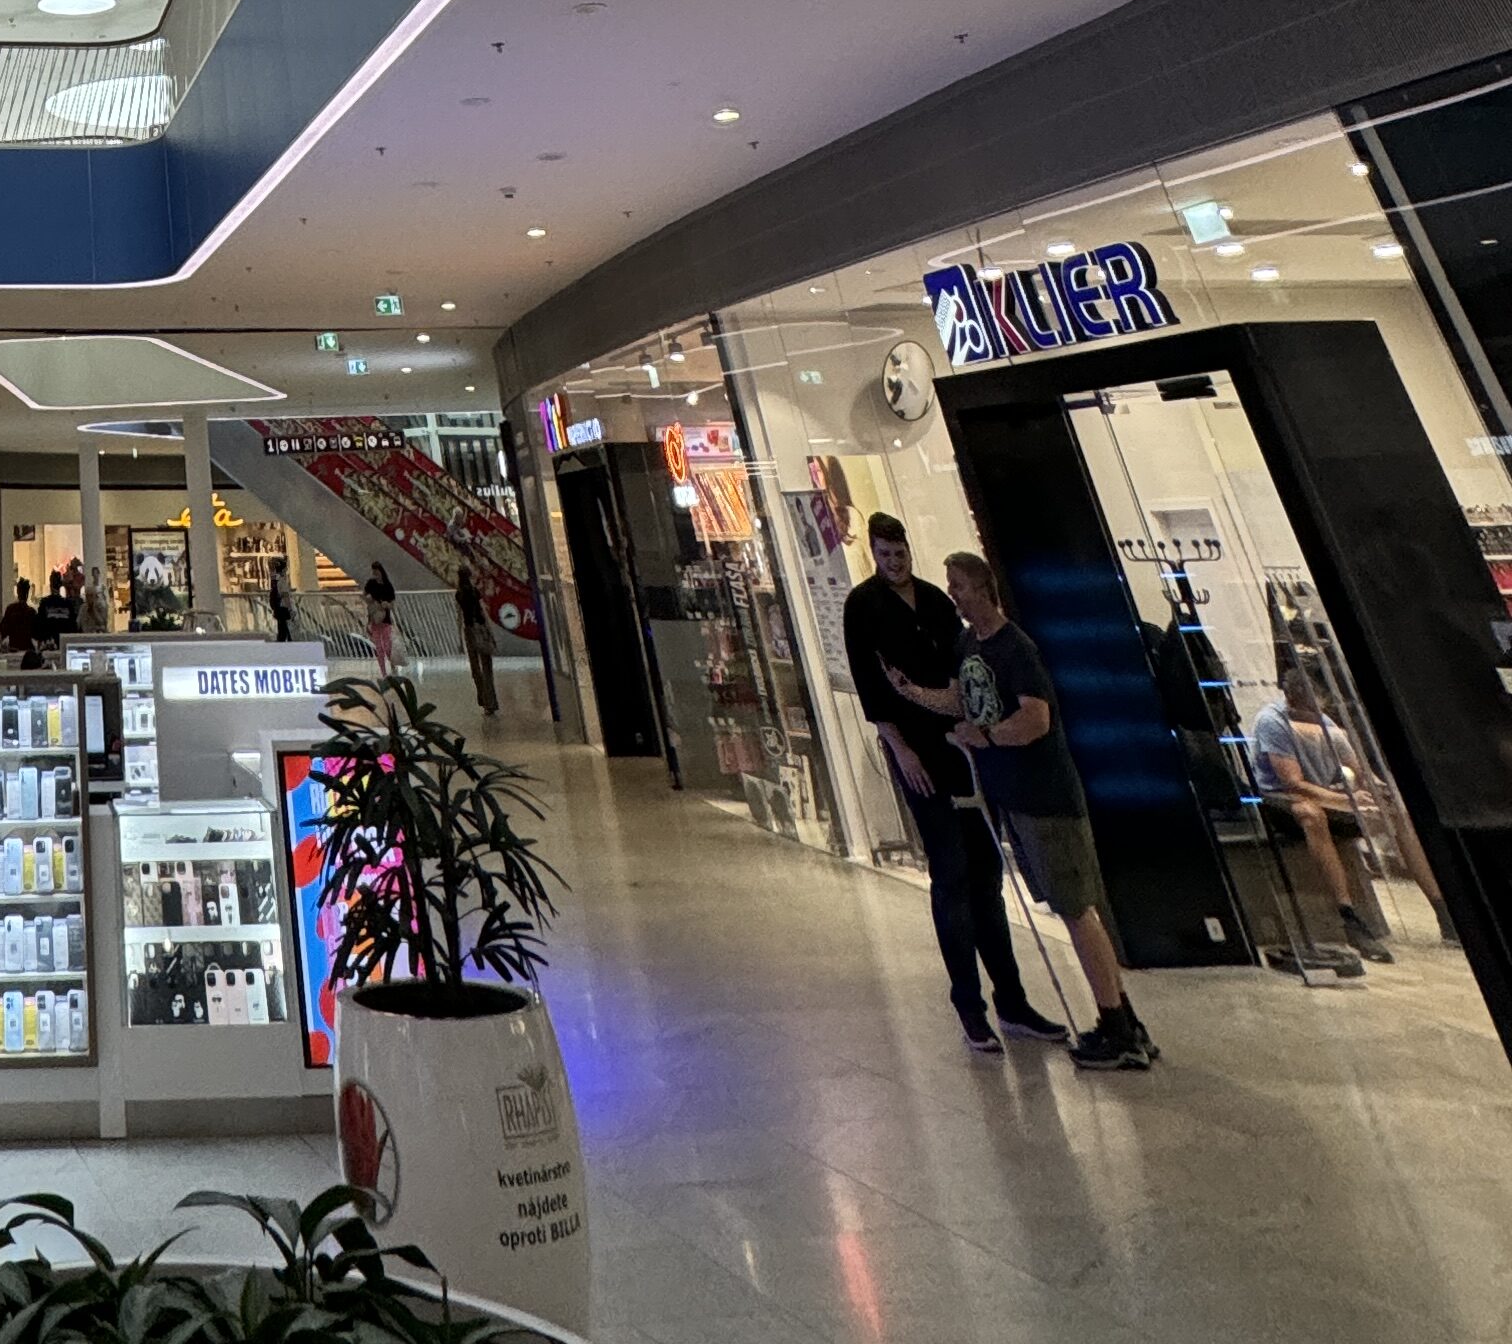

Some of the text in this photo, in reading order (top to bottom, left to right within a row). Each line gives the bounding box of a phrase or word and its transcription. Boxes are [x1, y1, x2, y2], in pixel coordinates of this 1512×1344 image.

[975, 242, 1172, 358] KLIER
[197, 669, 249, 695] DATES
[499, 1225, 548, 1250] oproti
